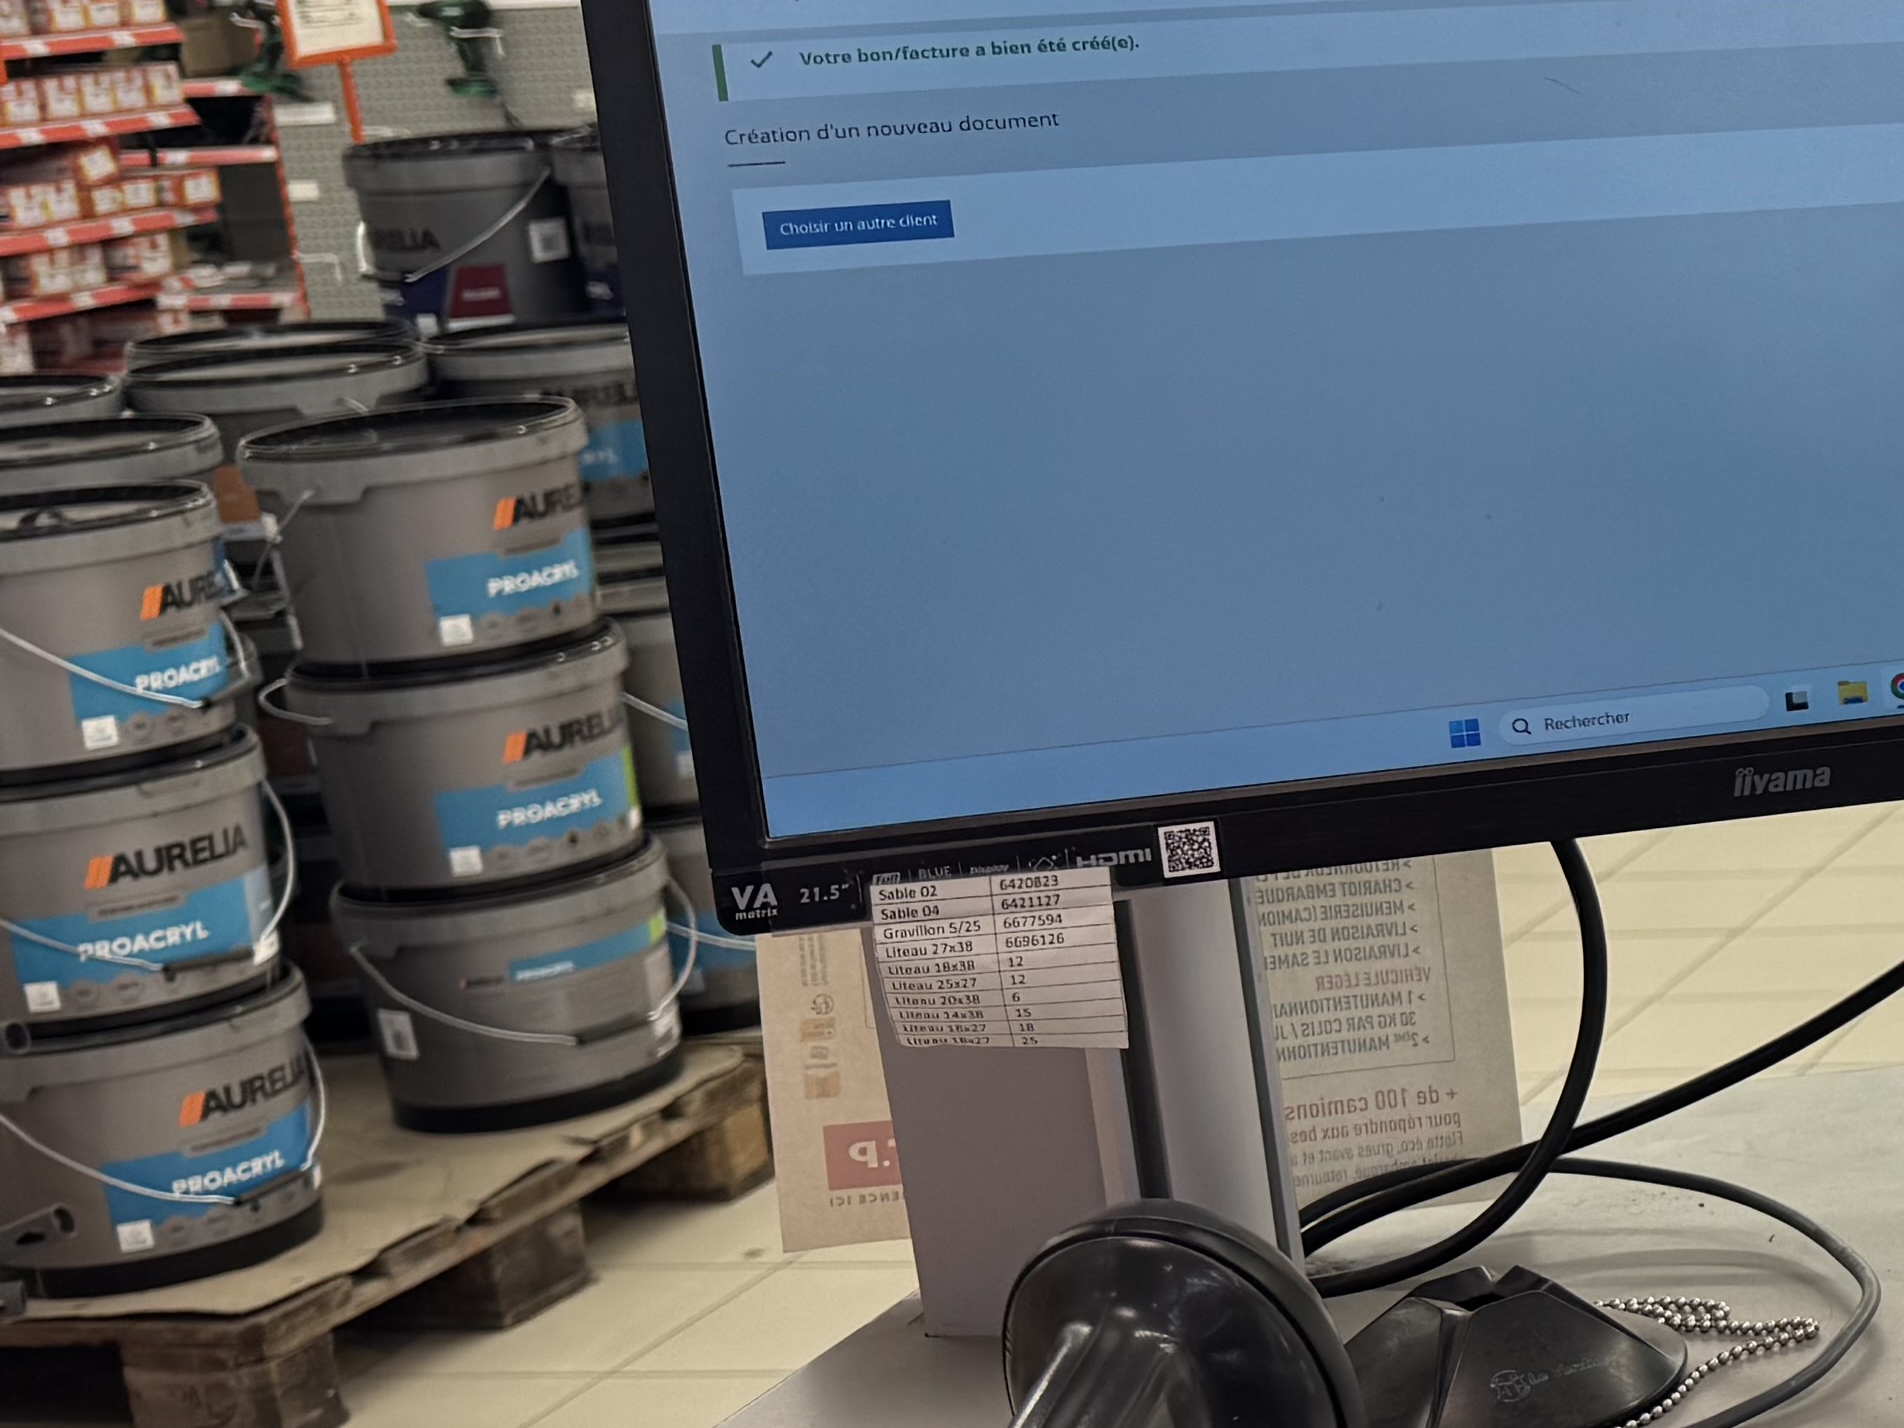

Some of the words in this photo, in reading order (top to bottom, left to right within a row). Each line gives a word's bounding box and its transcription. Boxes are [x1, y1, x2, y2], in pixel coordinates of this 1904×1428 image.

[800, 51, 852, 66] Votre
[858, 44, 970, 64] bon/facture
[976, 46, 986, 57] a
[991, 39, 1032, 56] bien
[1037, 37, 1067, 54] été
[1072, 35, 1139, 54] créé(e).
[725, 127, 810, 147] Création
[817, 123, 860, 141] d'un
[867, 119, 953, 138] nouveau
[959, 112, 1060, 133] document
[780, 221, 830, 236] Choisir
[835, 220, 854, 233] un
[857, 217, 894, 231] autre
[899, 214, 938, 228] client
[1543, 708, 1633, 733] Rechercher
[109, 824, 249, 883] AURELIA
[1076, 848, 1152, 868] HDMI
[731, 884, 778, 910] VA
[879, 887, 916, 901] Sable
[920, 884, 938, 898] 02
[999, 875, 1059, 891] 6420823
[734, 906, 779, 921] matrix
[881, 907, 918, 921] Sable
[1001, 894, 1061, 911] 6421127
[1003, 912, 1063, 929] 6677594
[77, 921, 210, 963] PROACRYL
